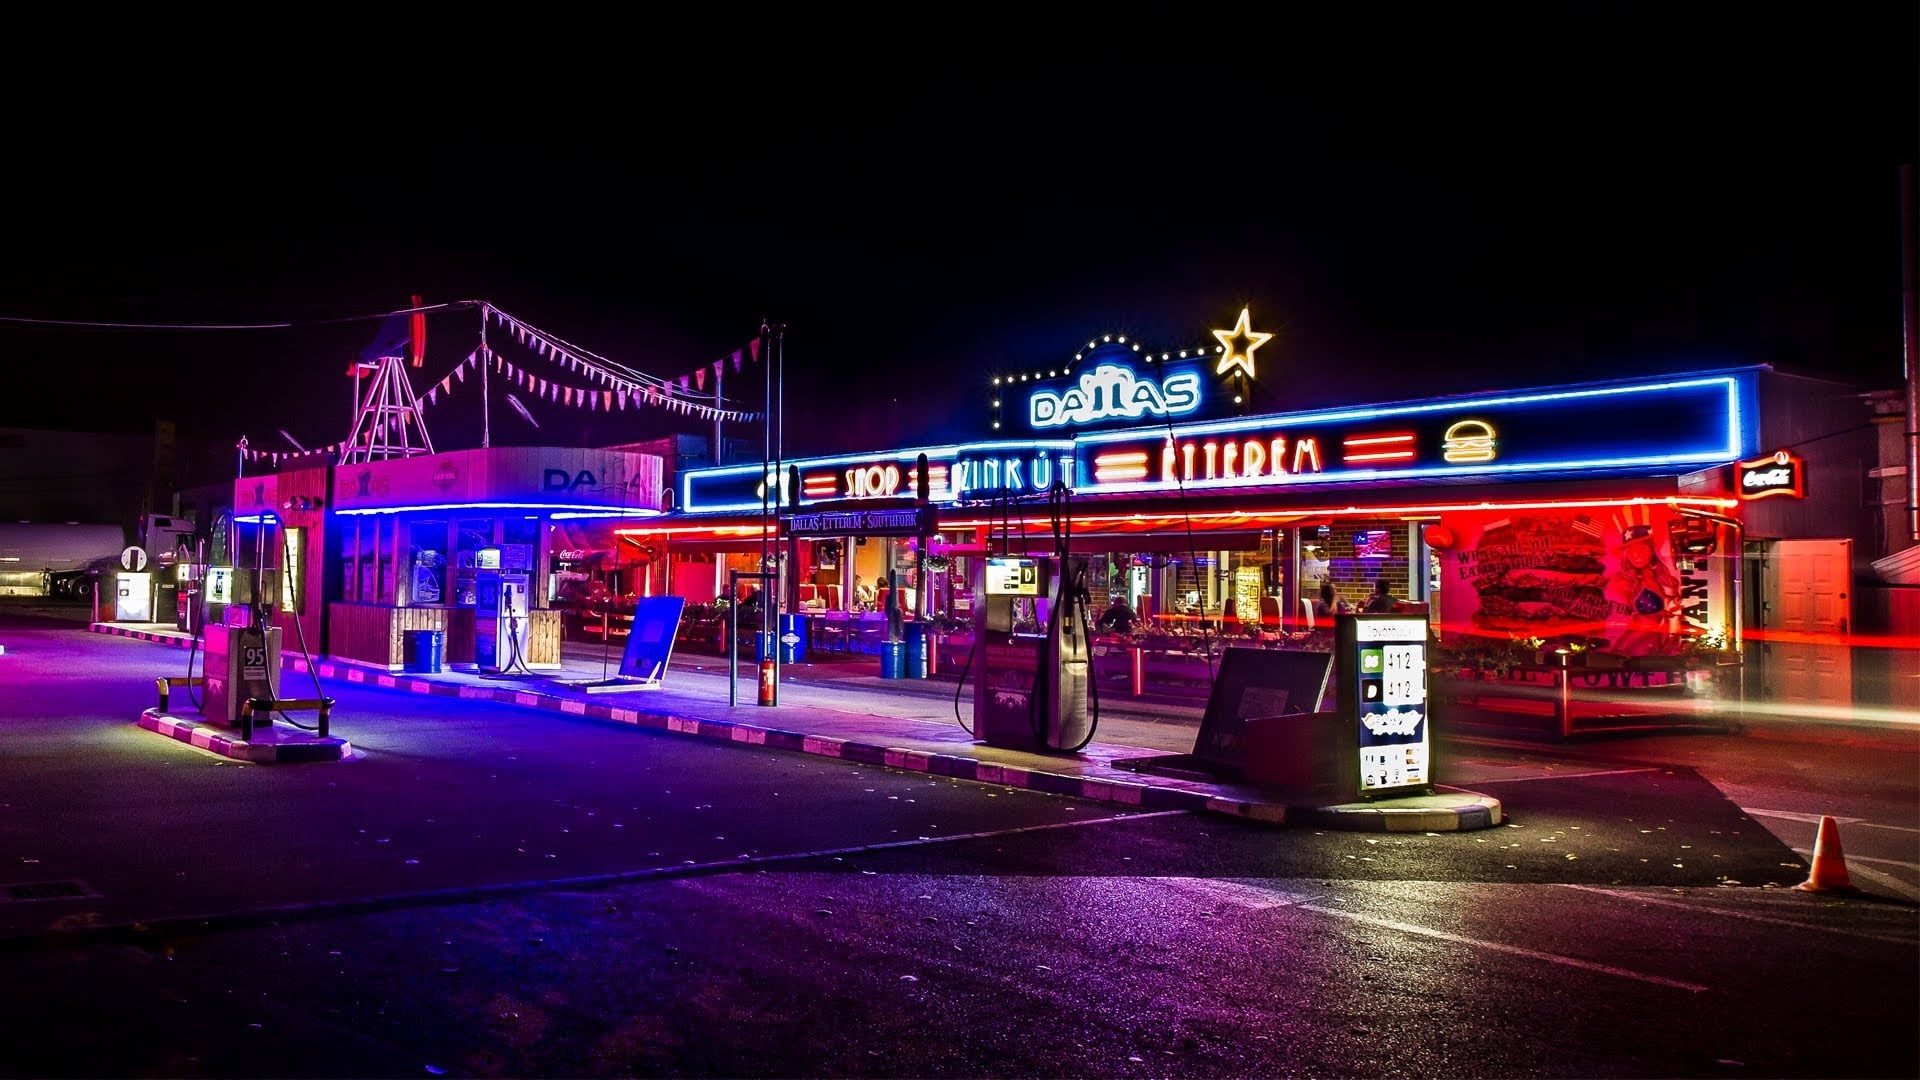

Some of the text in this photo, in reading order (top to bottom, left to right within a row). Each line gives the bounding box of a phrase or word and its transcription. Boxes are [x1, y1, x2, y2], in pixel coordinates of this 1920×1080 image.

[1031, 366, 1199, 425] DALLAS
[790, 518, 819, 531] DALLAS
[867, 514, 917, 529] SOUTHFORK
[1680, 517, 1708, 642] WANTD
[246, 648, 265, 666] 95
[1388, 652, 1411, 670] 412
[1388, 680, 1411, 698] 412
